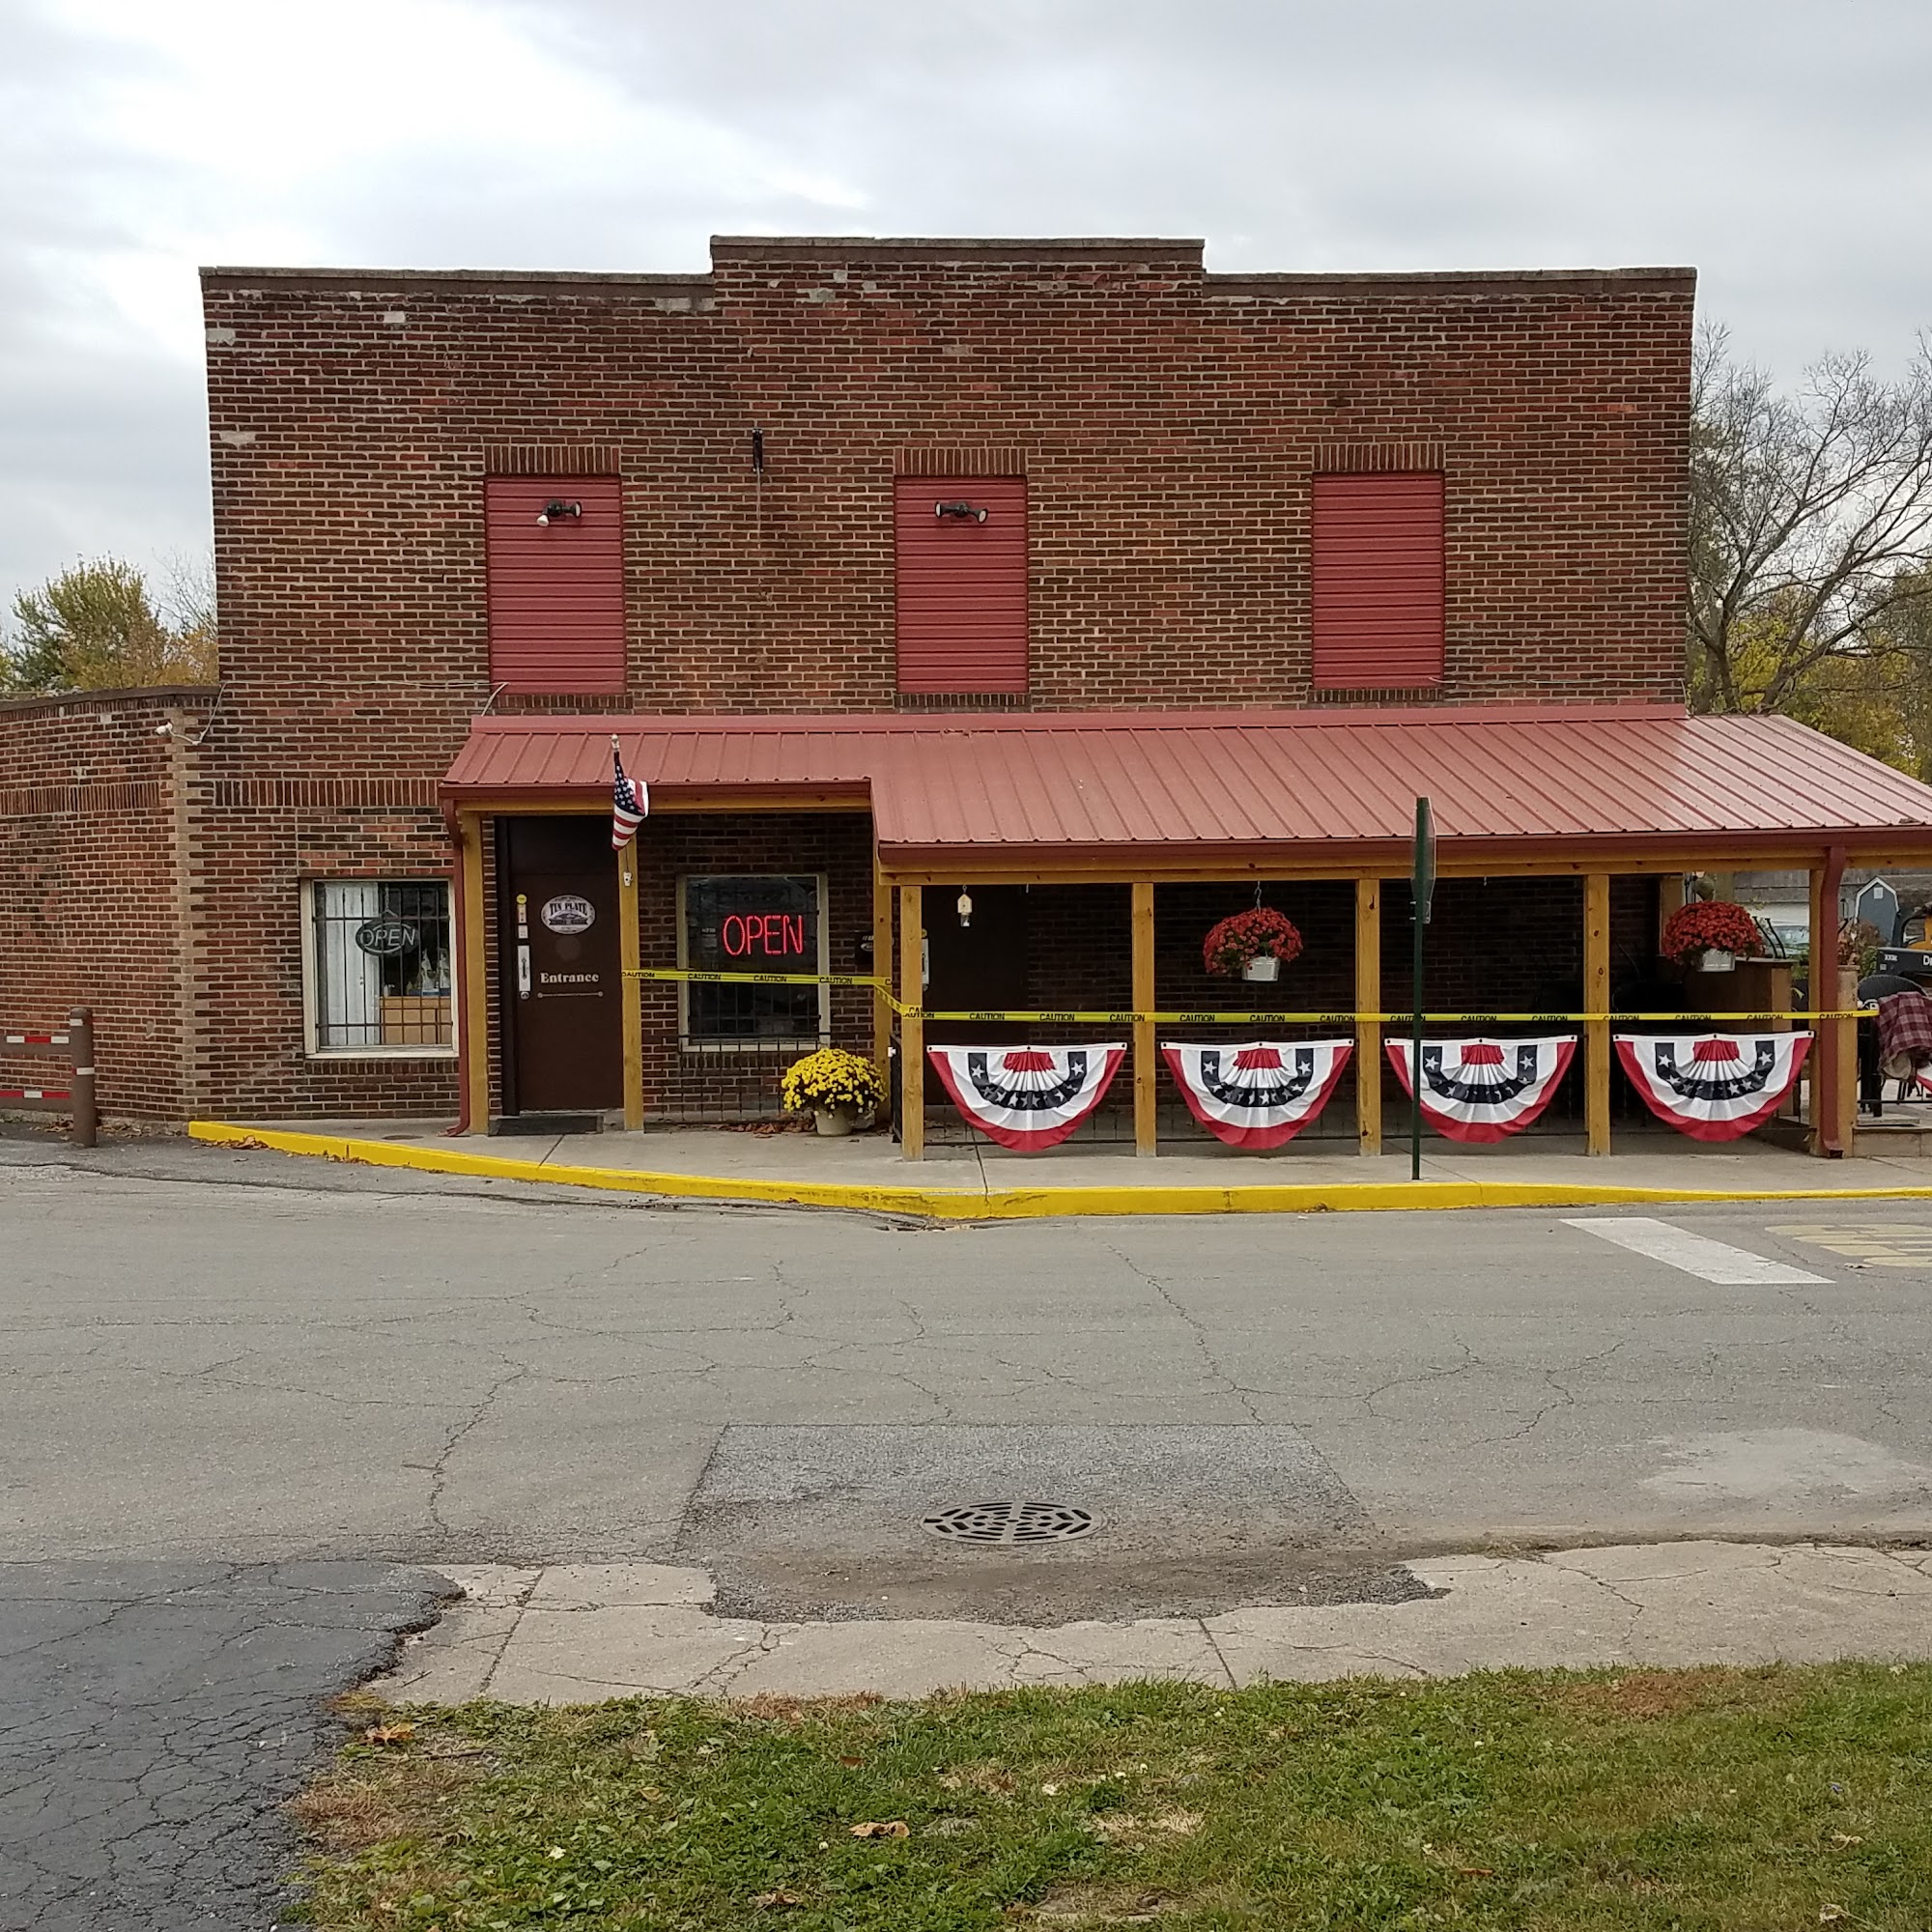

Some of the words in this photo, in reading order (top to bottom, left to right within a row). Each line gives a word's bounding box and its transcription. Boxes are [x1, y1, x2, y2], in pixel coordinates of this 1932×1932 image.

[549, 902, 562, 917] TIN
[564, 902, 588, 916] PLATE
[360, 928, 416, 947] OPEN
[723, 915, 804, 955] OPEN
[539, 972, 600, 984] Entrance
[819, 976, 853, 984] CAUTION
